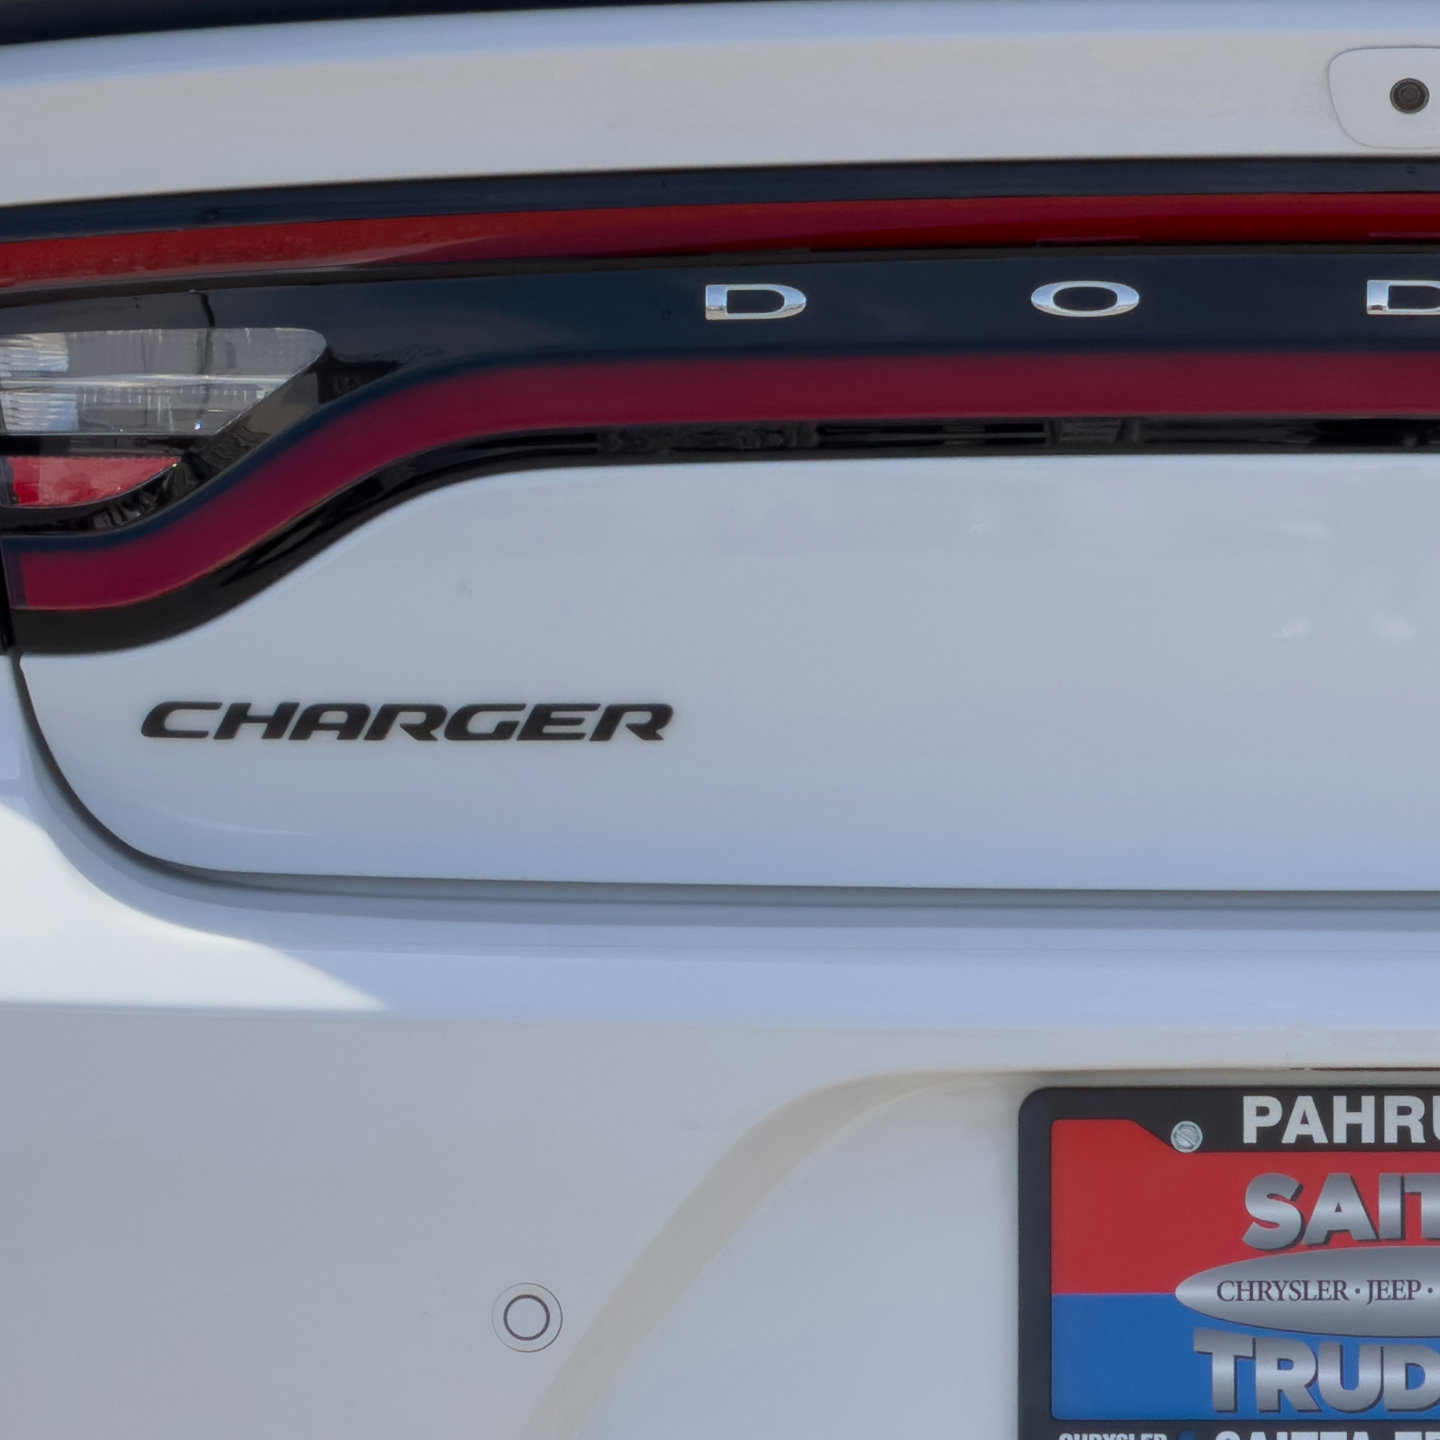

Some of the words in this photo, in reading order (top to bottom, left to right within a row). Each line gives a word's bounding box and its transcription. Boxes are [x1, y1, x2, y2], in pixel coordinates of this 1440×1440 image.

[140, 701, 674, 742] CHARGER
[1216, 1279, 1350, 1303] CHRYSLER
[1366, 1279, 1422, 1306] JEEP
